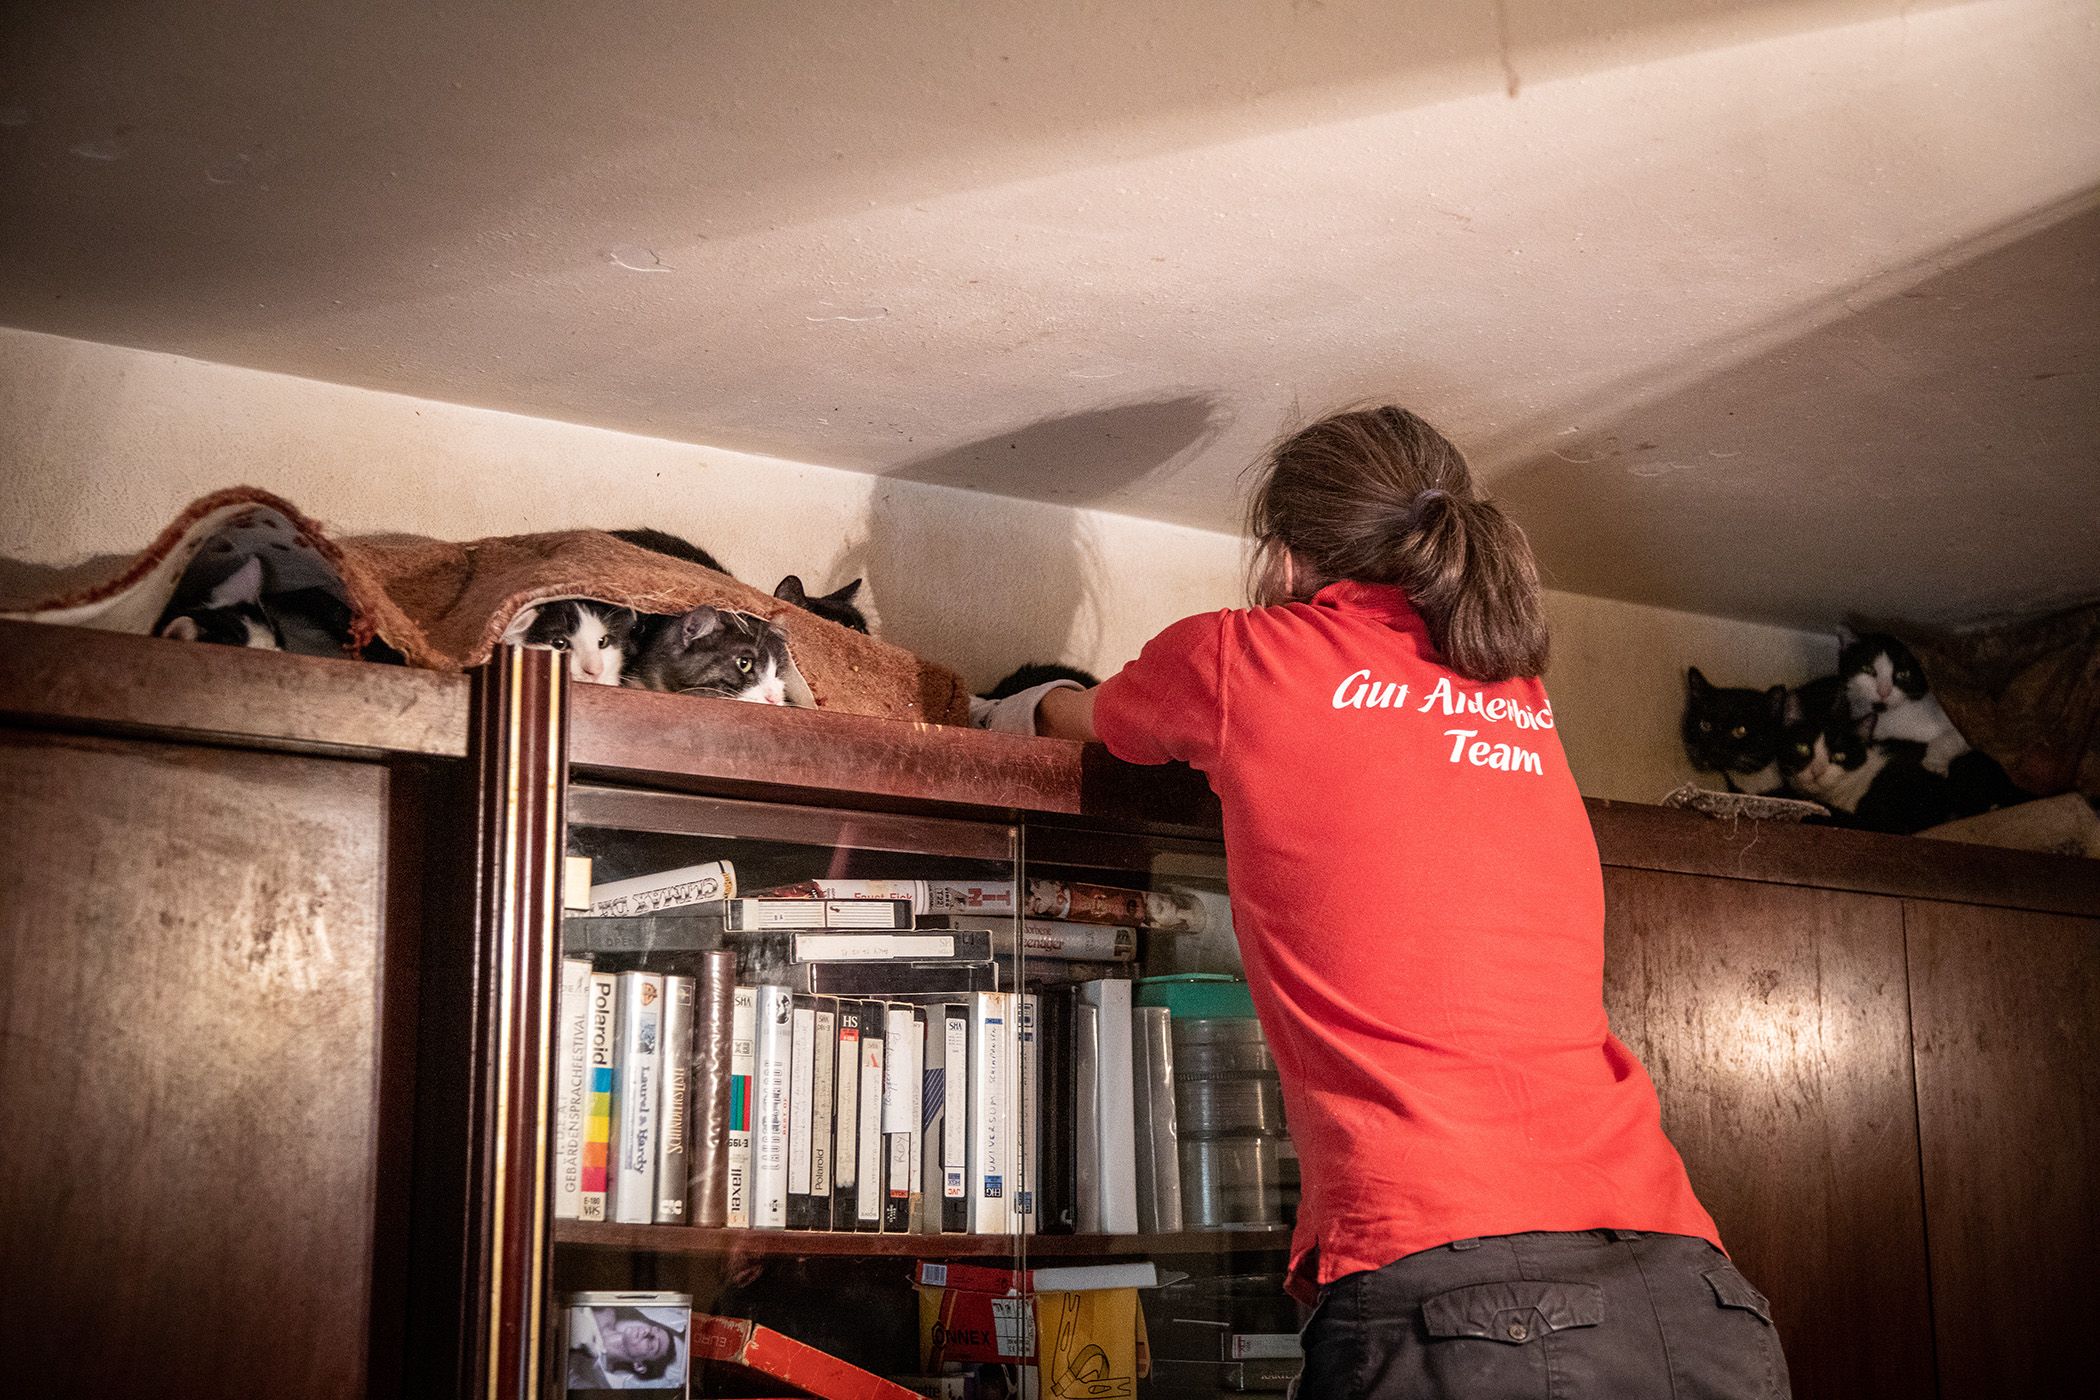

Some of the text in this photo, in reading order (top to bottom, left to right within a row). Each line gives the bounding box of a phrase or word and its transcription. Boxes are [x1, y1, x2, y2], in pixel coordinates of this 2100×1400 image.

[1331, 669, 1410, 709] Gut
[1443, 729, 1544, 776] Team
[632, 877, 719, 913] CLIMAX
[734, 996, 752, 1008] VHS
[592, 982, 611, 1065] Polaroid
[948, 1021, 963, 1031] VHS
[564, 1014, 585, 1193] GEBÄRDENSPRACHFESTIVAL
[639, 1066, 650, 1113] Laurel
[634, 1128, 648, 1175] Hardy
[894, 1135, 908, 1163] ROY
[988, 1096, 997, 1173] UNIVERSUM
[815, 1149, 824, 1191] Polaroid
[583, 1206, 600, 1216] VHS
